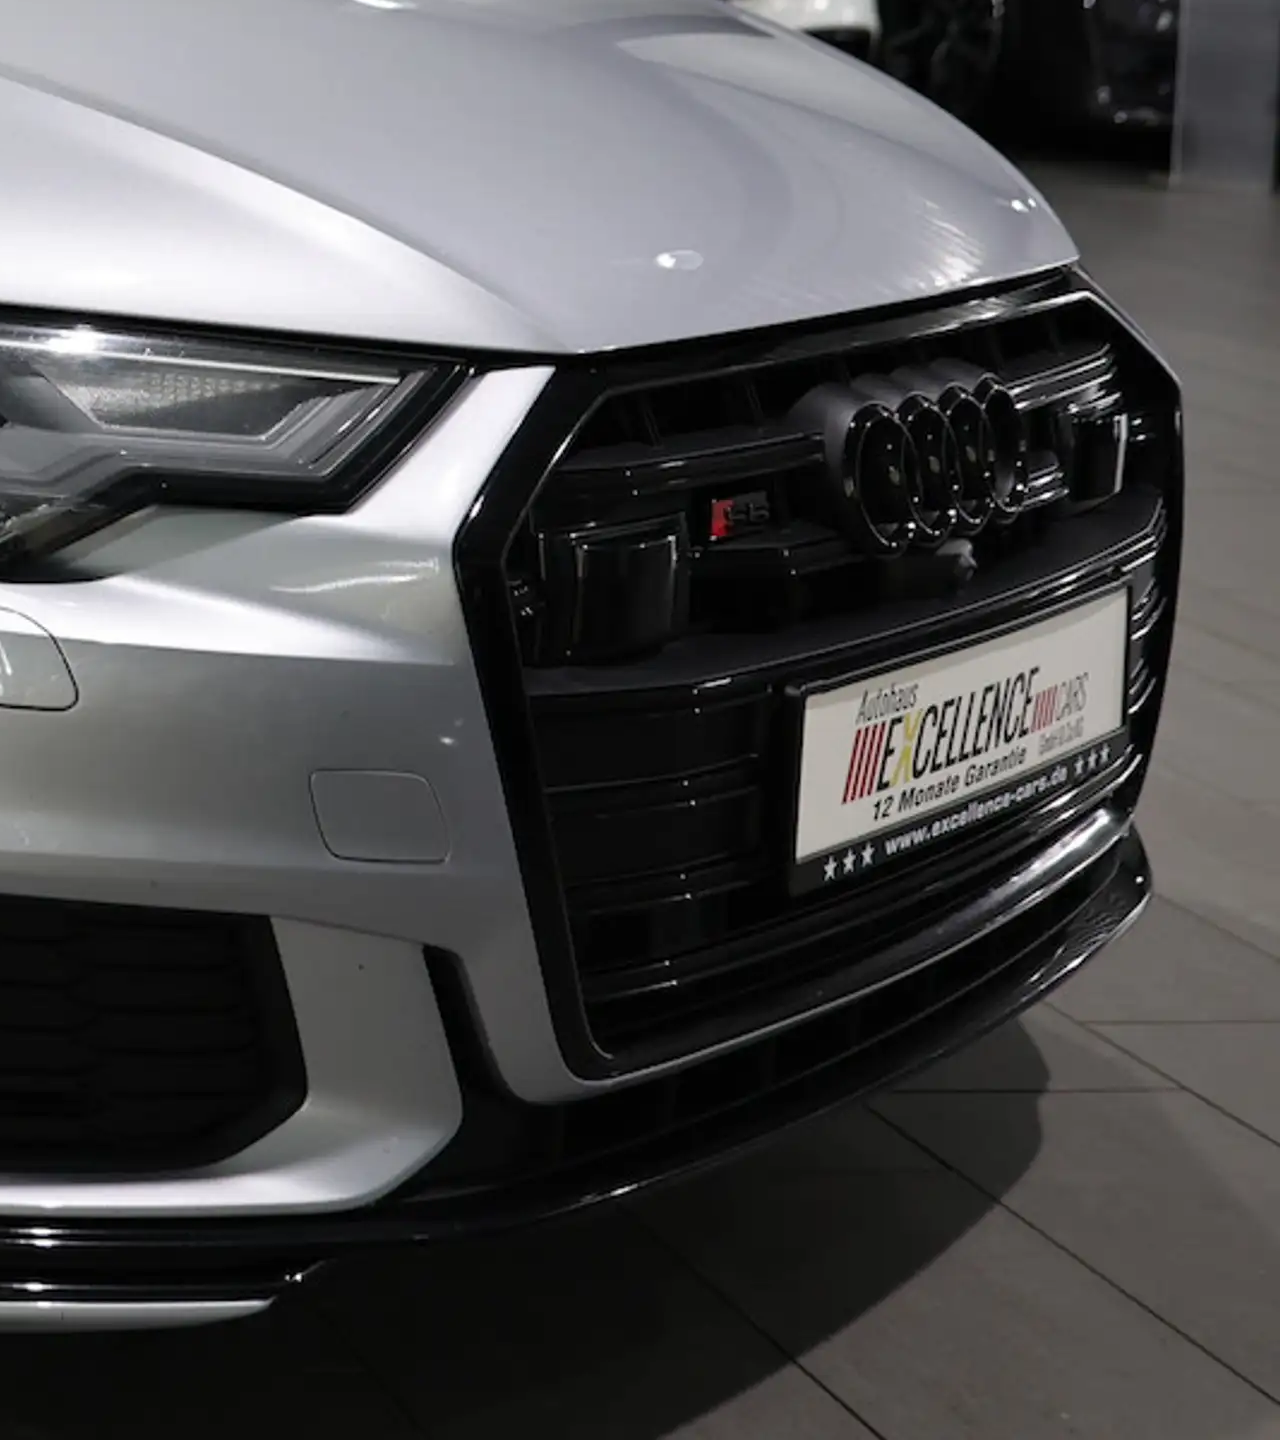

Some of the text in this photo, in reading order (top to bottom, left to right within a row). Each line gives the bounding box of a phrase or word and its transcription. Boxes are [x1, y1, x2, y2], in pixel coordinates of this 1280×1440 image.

[856, 684, 918, 725] Autohaus
[875, 667, 1039, 792] EXCELLENCE
[1056, 672, 1089, 720] CARS
[873, 745, 1027, 820] 12 Monate Garantie
[884, 765, 1068, 855] www.excellence-cars.de
